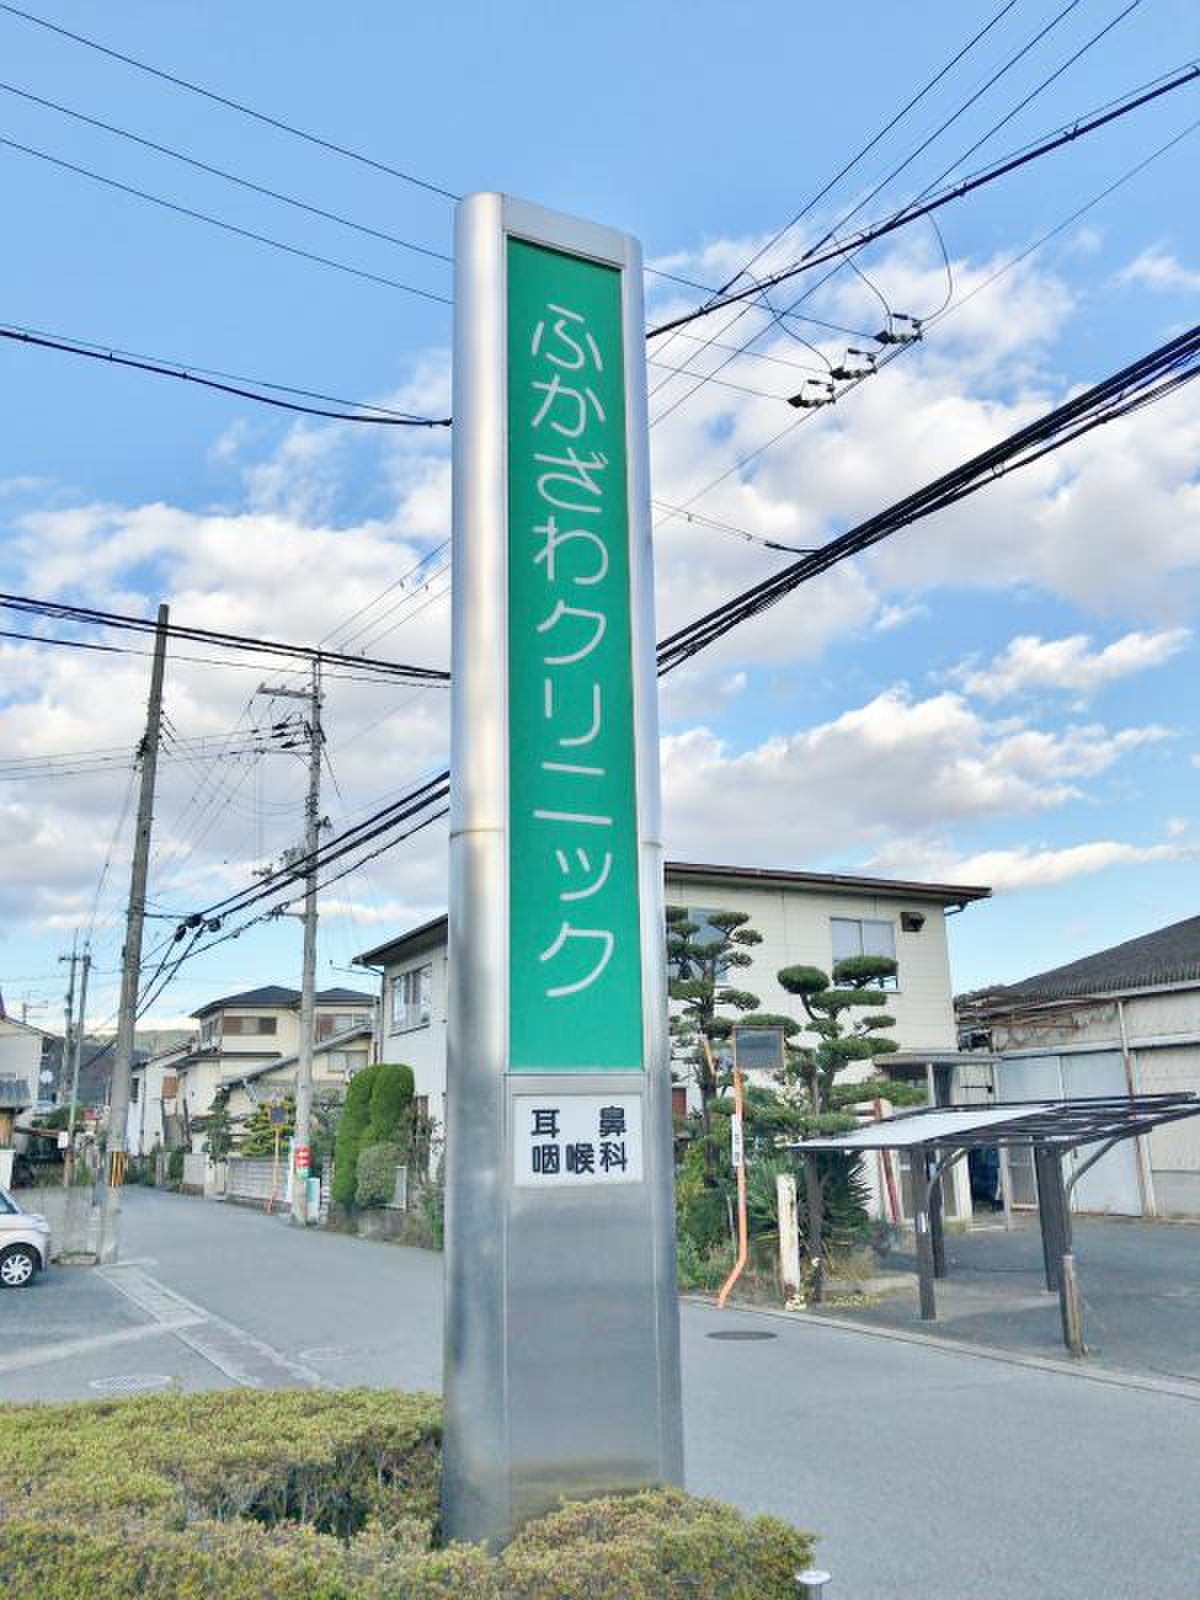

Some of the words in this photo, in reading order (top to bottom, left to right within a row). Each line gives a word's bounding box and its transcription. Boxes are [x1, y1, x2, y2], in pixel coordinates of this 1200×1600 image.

[531, 302, 615, 998] ふかざわクリニック
[532, 1141, 628, 1174] 咽喉科
